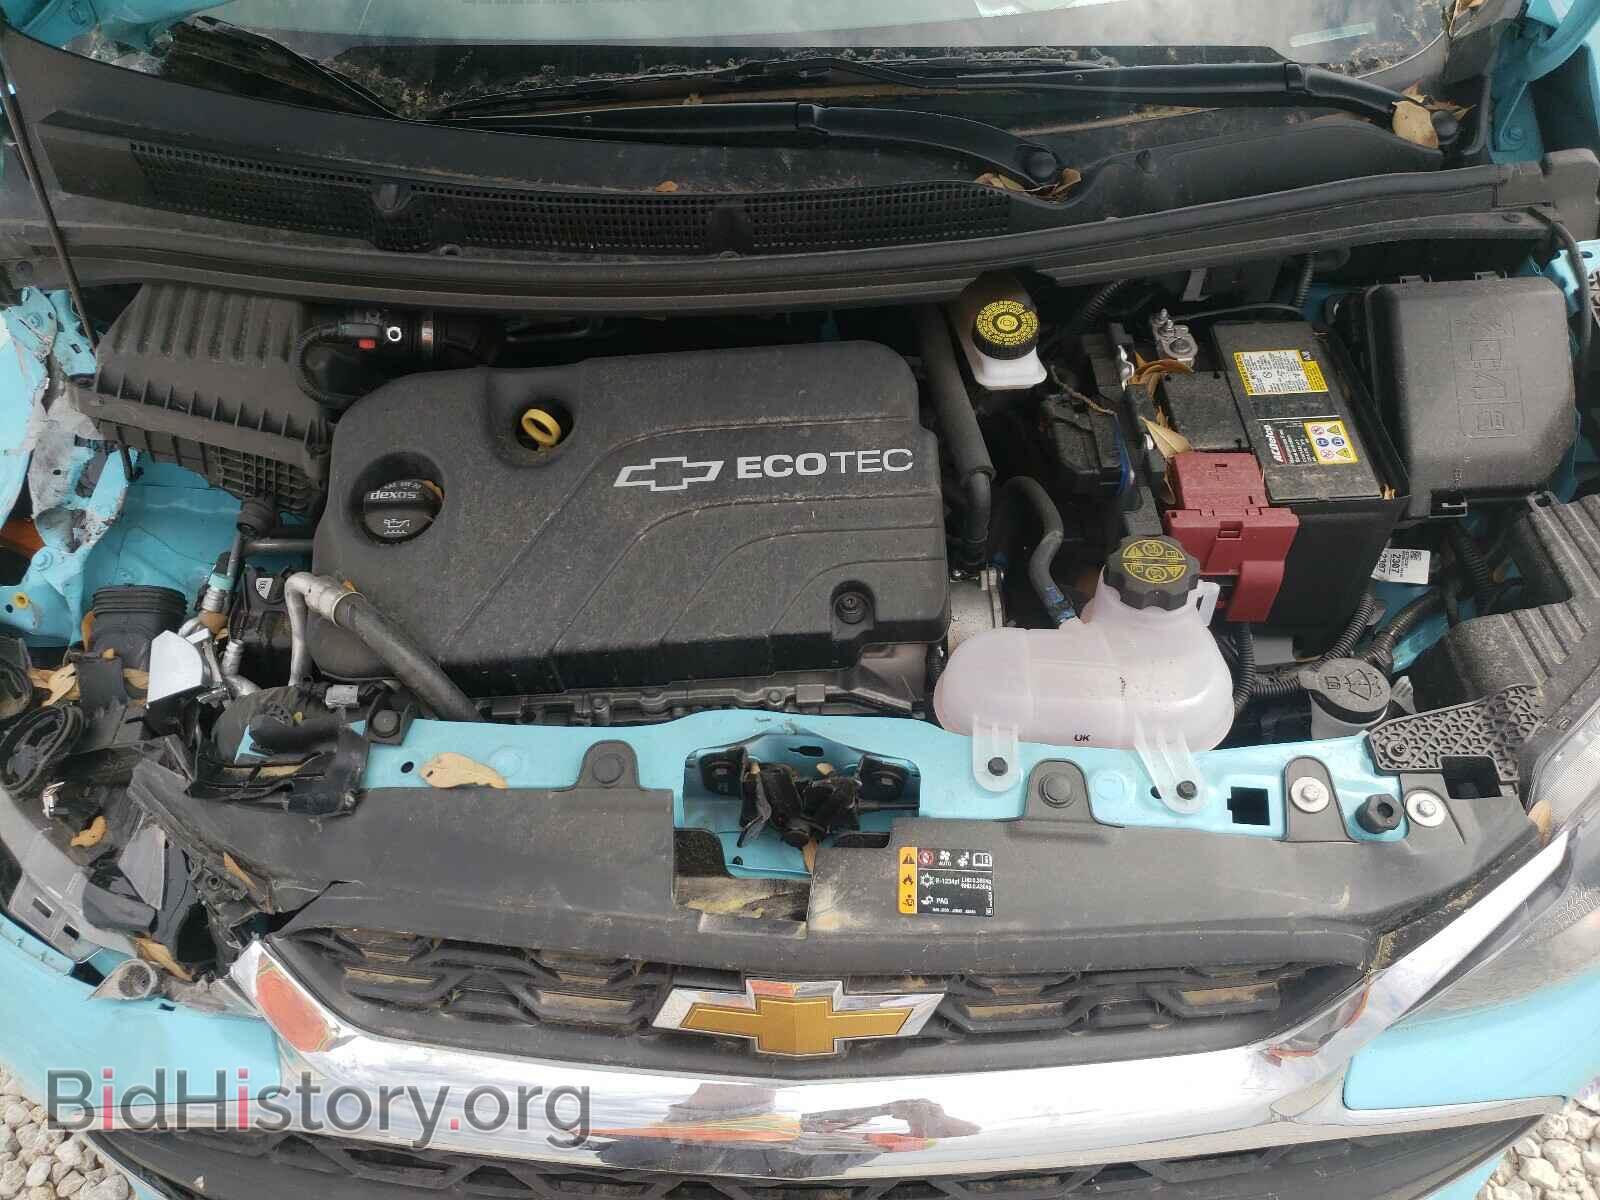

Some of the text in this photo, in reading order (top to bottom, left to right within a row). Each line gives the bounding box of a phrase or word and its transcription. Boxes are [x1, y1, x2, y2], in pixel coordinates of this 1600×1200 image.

[736, 448, 914, 479] ECOTEC
[370, 490, 417, 500] dexos
[1391, 553, 1401, 574] 2307
